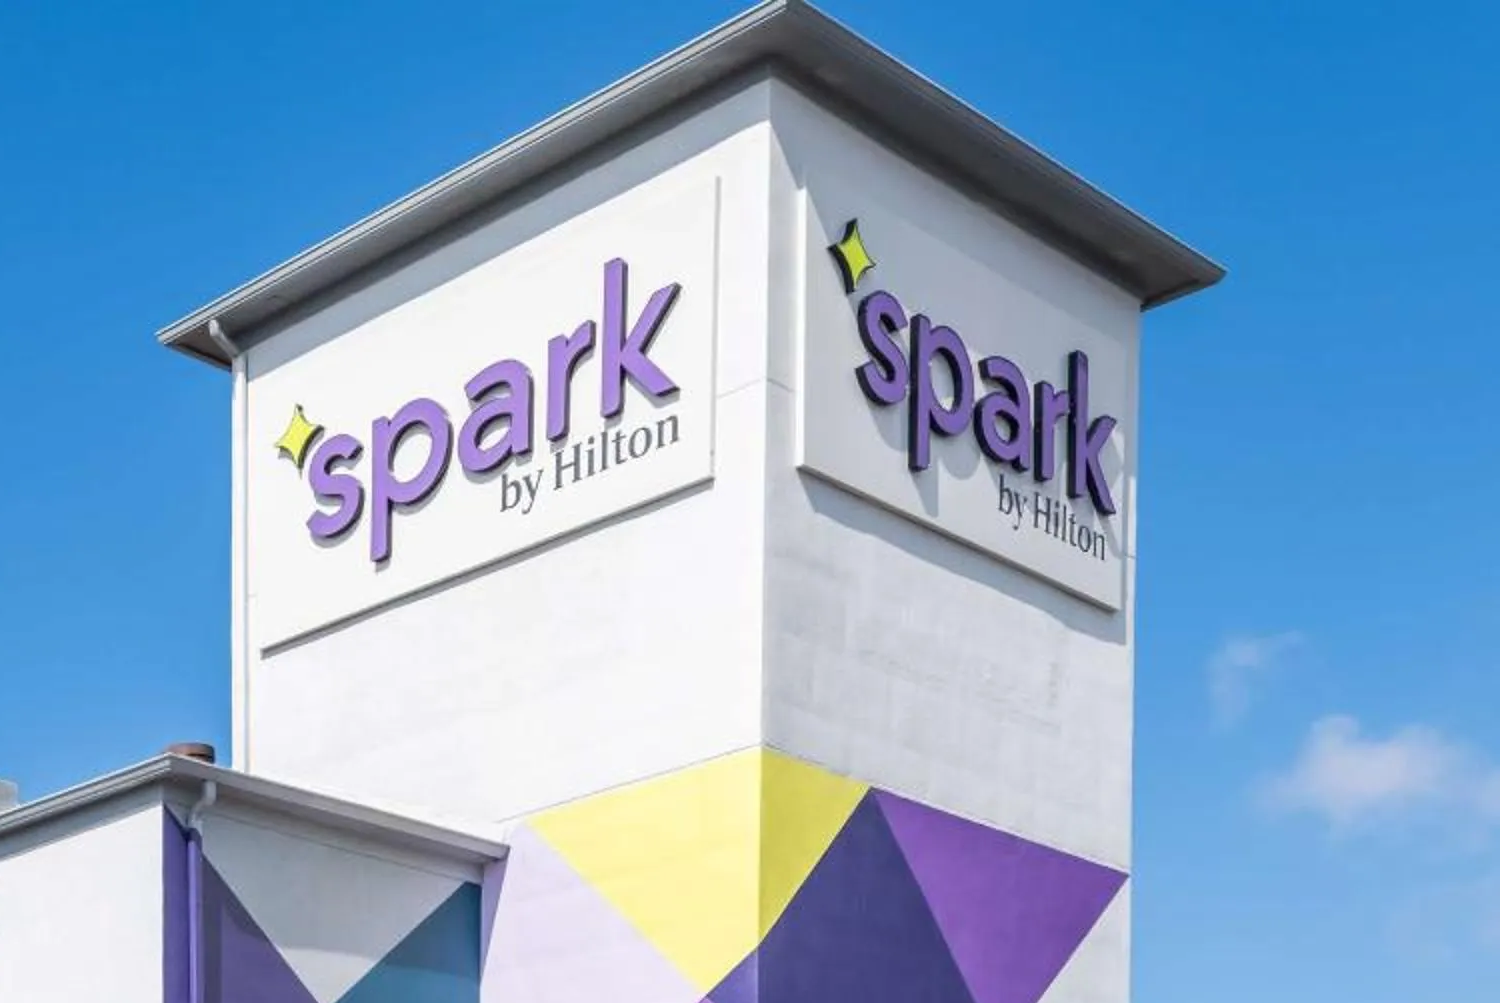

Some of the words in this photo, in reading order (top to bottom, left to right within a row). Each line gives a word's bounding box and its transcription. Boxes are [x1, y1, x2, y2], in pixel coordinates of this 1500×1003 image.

[306, 257, 683, 564] spark
[500, 469, 544, 515] by
[553, 404, 680, 491] Hilton
[855, 289, 1118, 516] spark
[998, 473, 1028, 531] by
[1033, 491, 1105, 561] Hilton
